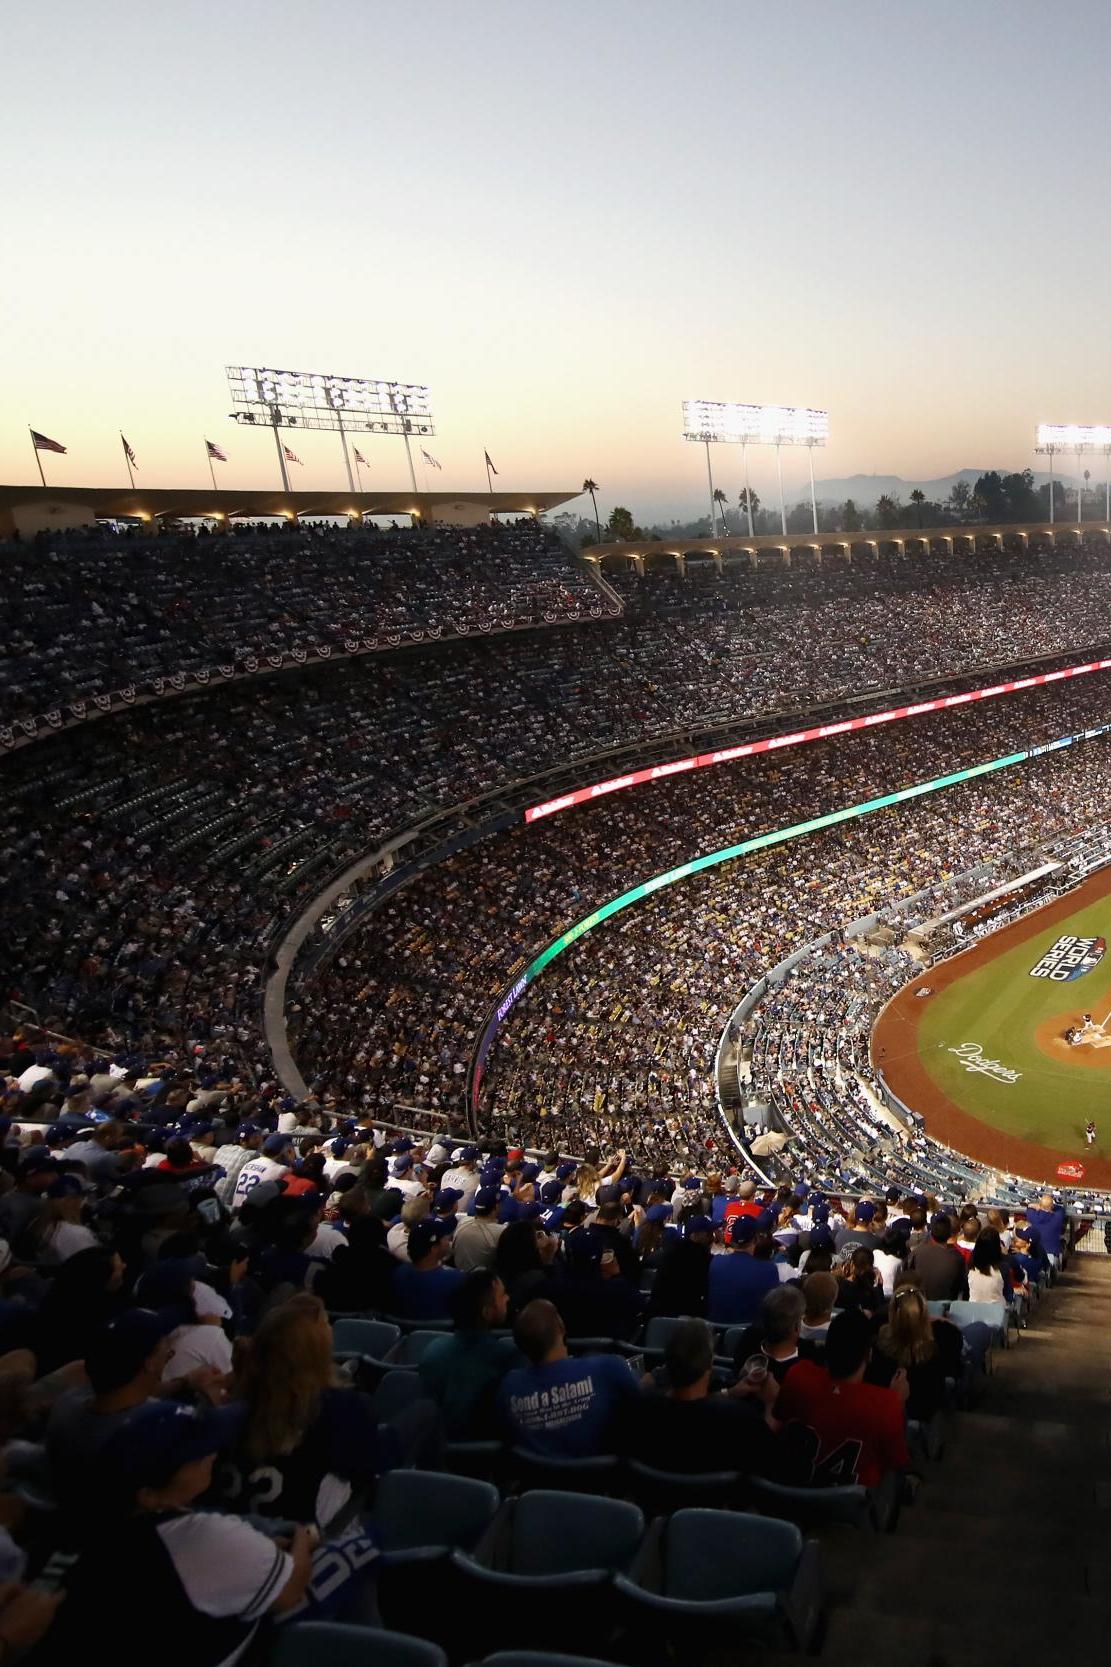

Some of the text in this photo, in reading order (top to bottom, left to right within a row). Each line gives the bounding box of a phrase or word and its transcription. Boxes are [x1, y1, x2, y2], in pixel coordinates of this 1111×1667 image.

[1029, 935, 1078, 978] SERIES
[1049, 938, 1097, 981] WORLD
[948, 1043, 1023, 1083] Dodgers
[510, 1391, 540, 1413] Send
[541, 1391, 549, 1407] a
[551, 1375, 594, 1404] Salami
